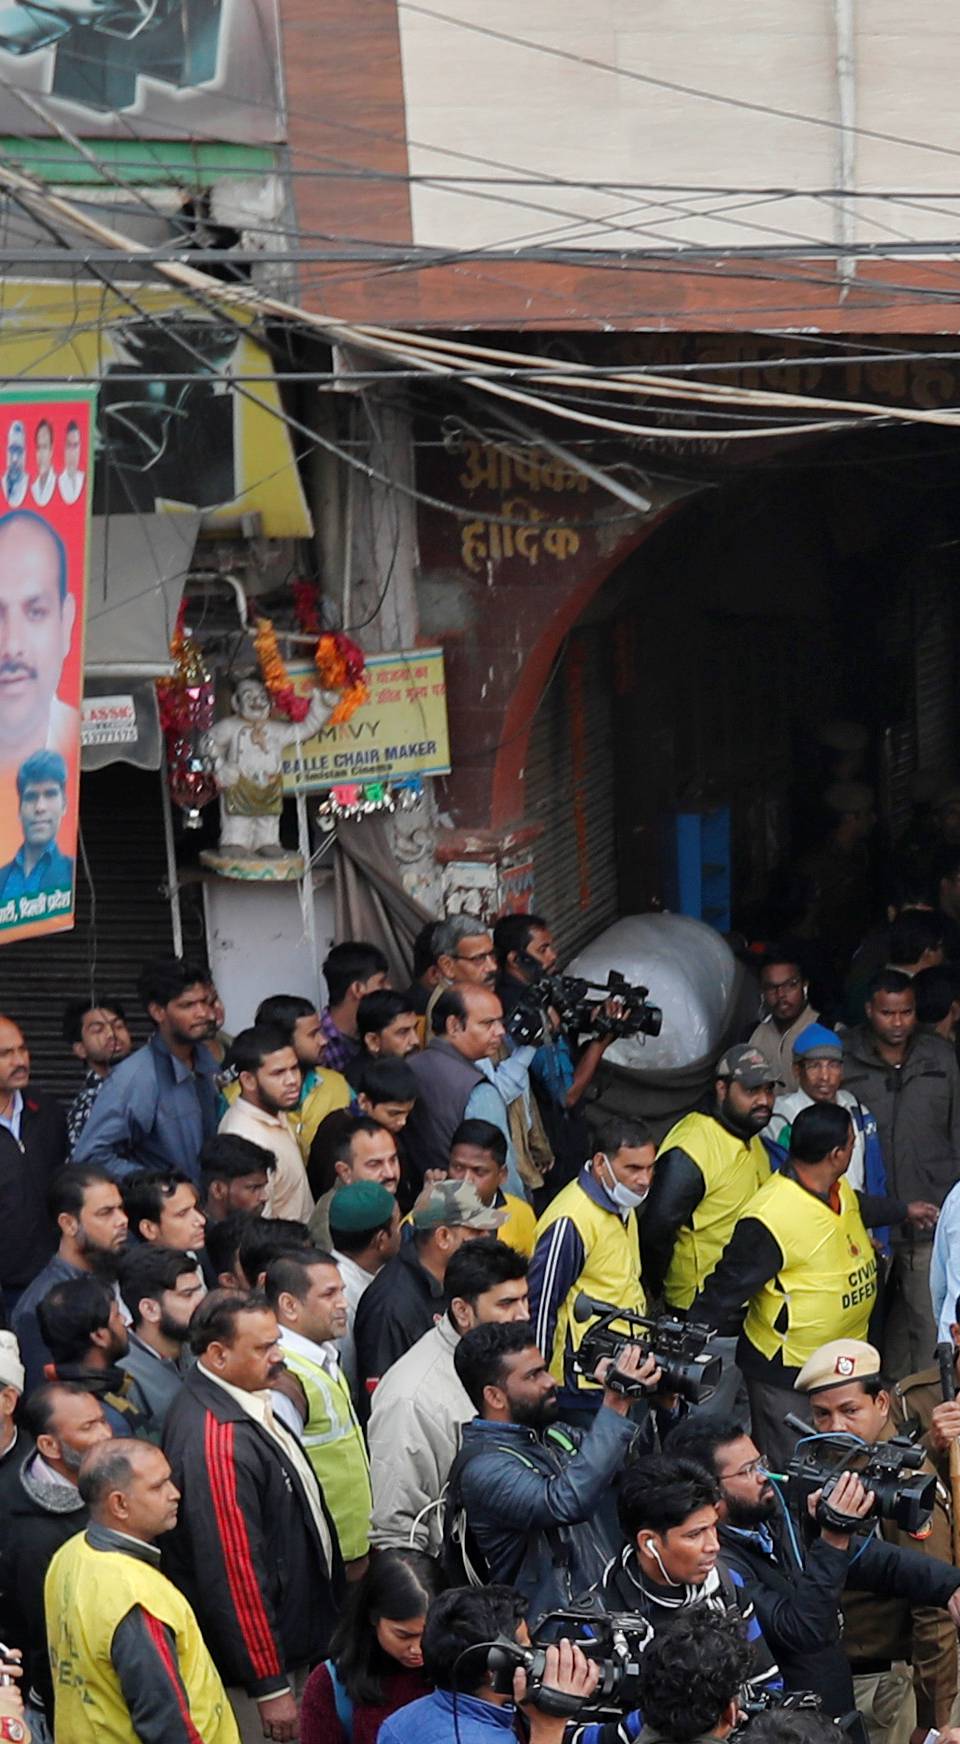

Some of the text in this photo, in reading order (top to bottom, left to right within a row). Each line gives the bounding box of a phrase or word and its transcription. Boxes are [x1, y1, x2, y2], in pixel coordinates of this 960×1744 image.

[333, 748, 381, 768] CHAIR
[384, 740, 437, 762] MAKER
[847, 1259, 878, 1287] CIVIL
[841, 1281, 876, 1309] DEFEN
